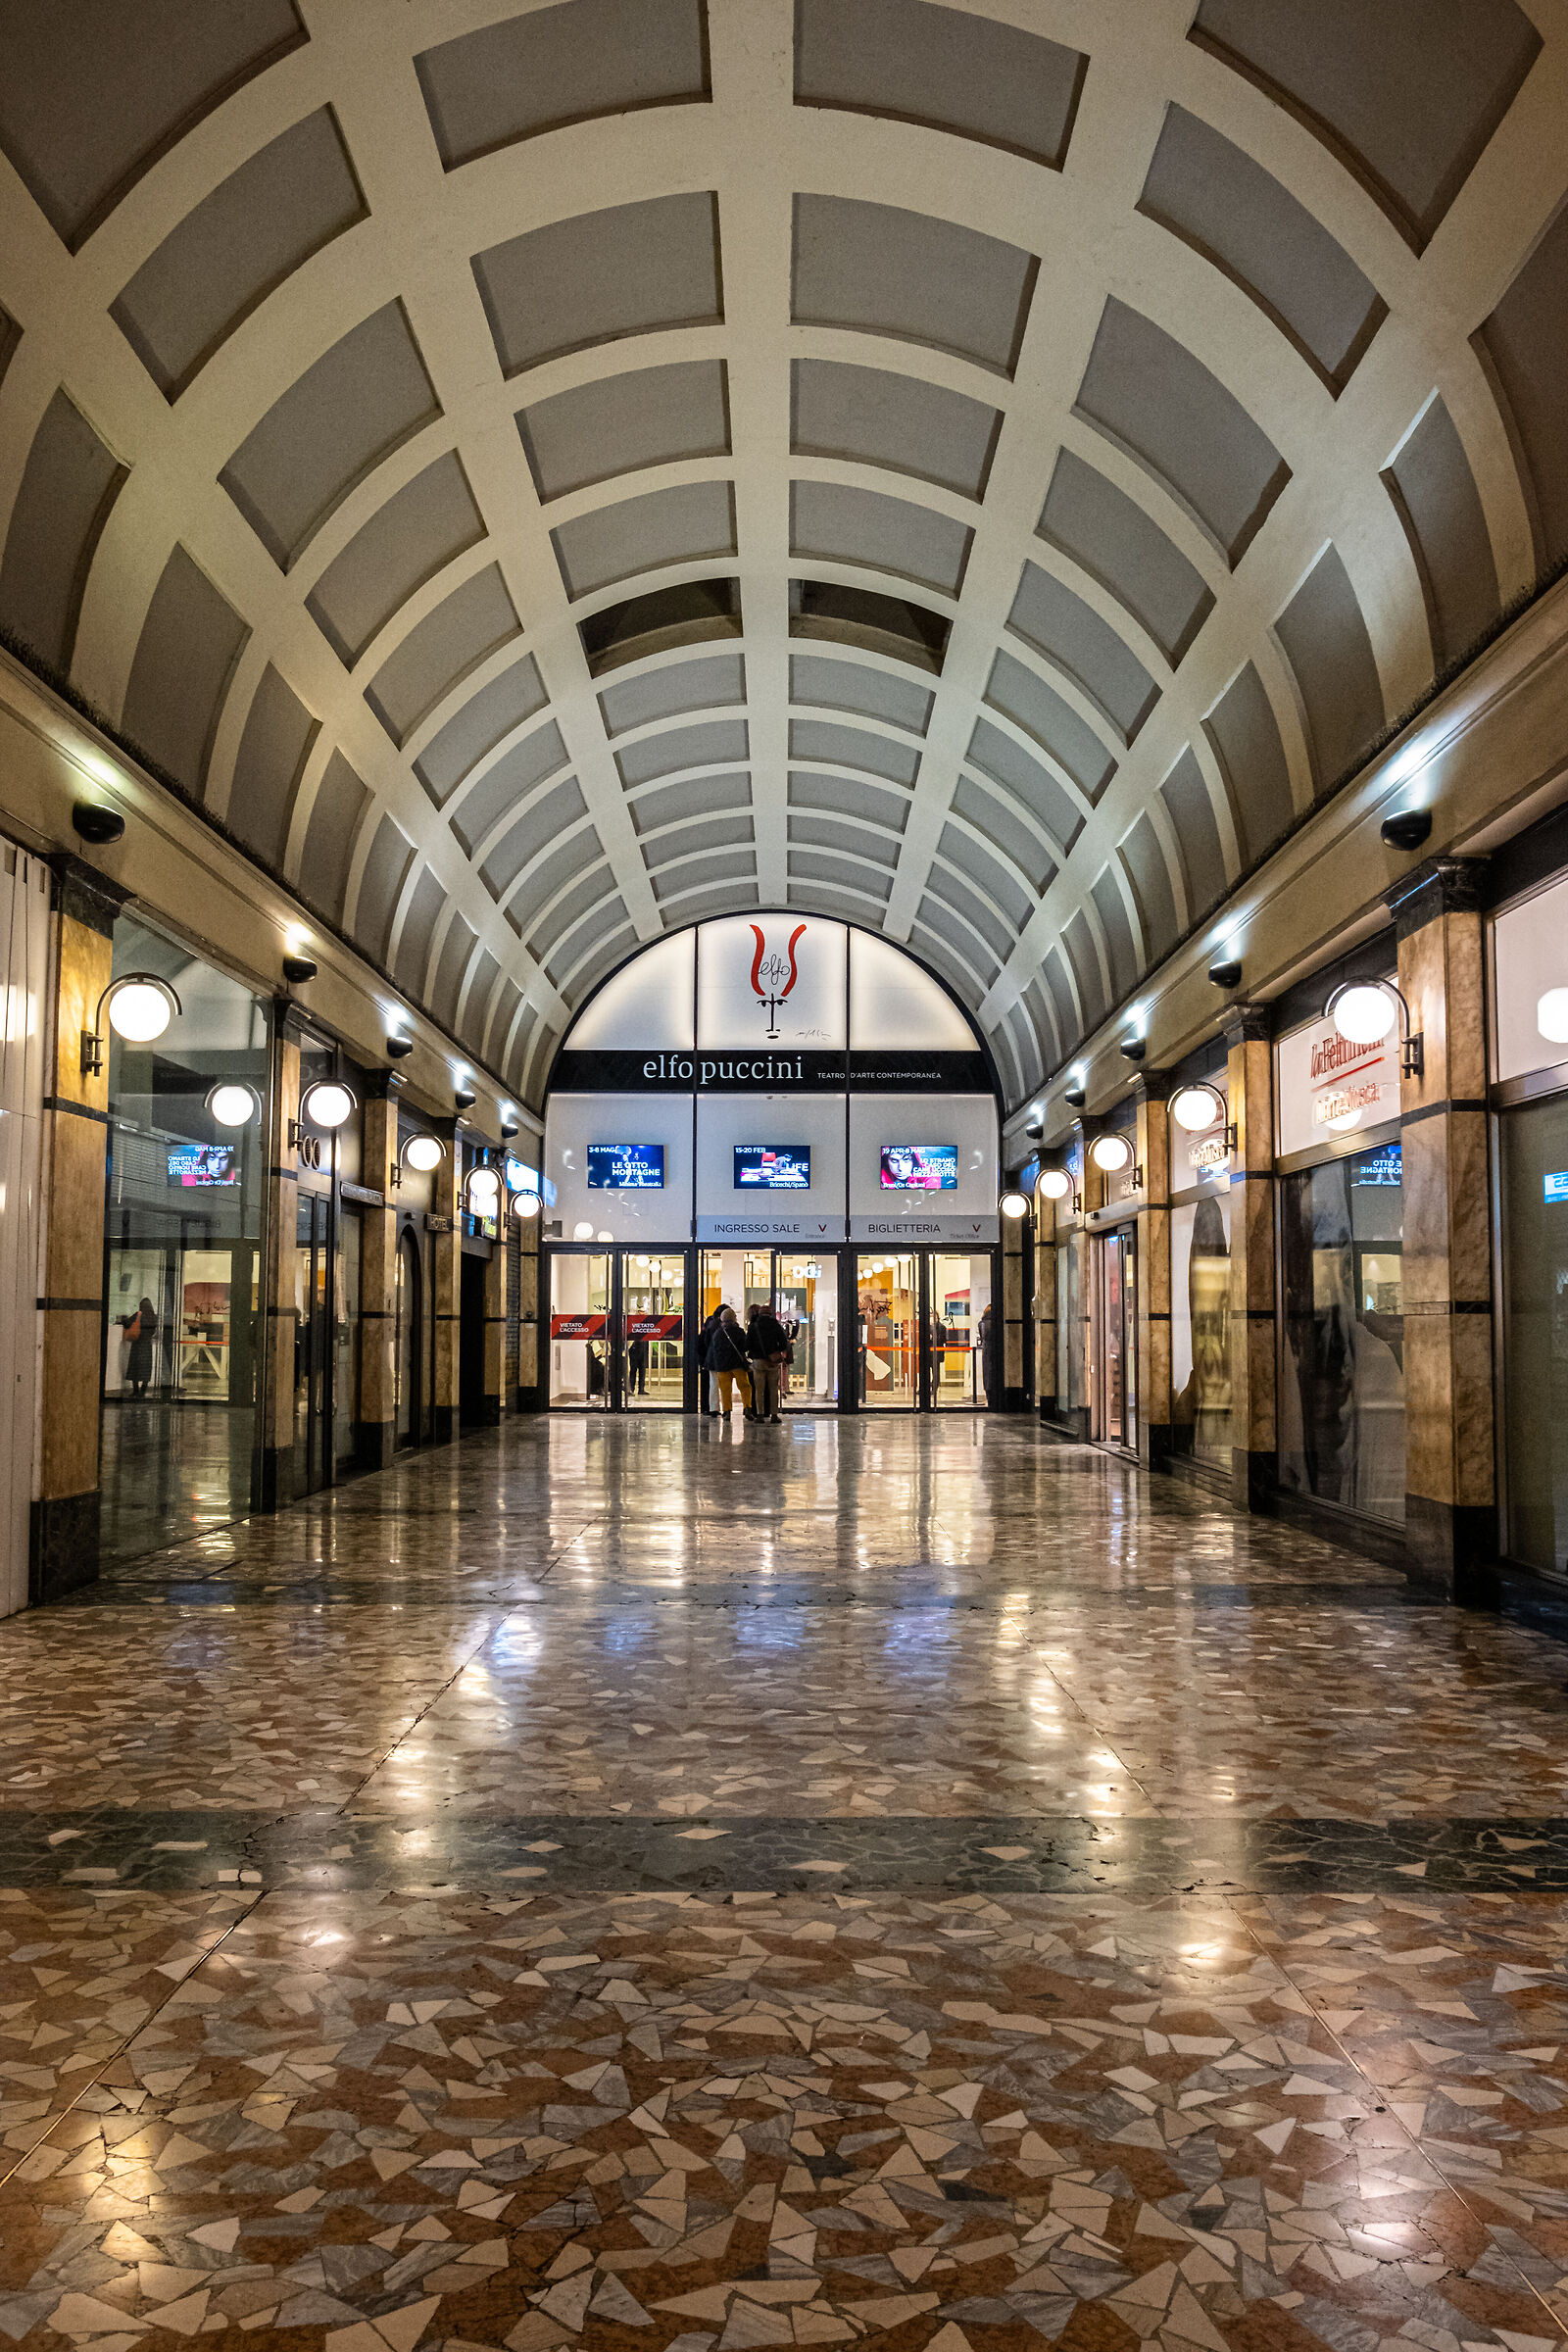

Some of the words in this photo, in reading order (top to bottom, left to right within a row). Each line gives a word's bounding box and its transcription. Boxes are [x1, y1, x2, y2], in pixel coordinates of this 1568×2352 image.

[758, 954, 791, 986] elfo
[643, 1054, 694, 1079] elfo
[699, 1055, 804, 1085] puccini
[786, 1162, 809, 1172] LIFE
[431, 1216, 449, 1230] HOTEL
[713, 1223, 769, 1233] INGRESSO
[772, 1223, 801, 1233] SALE
[867, 1223, 942, 1233] BIGLIETTERIA
